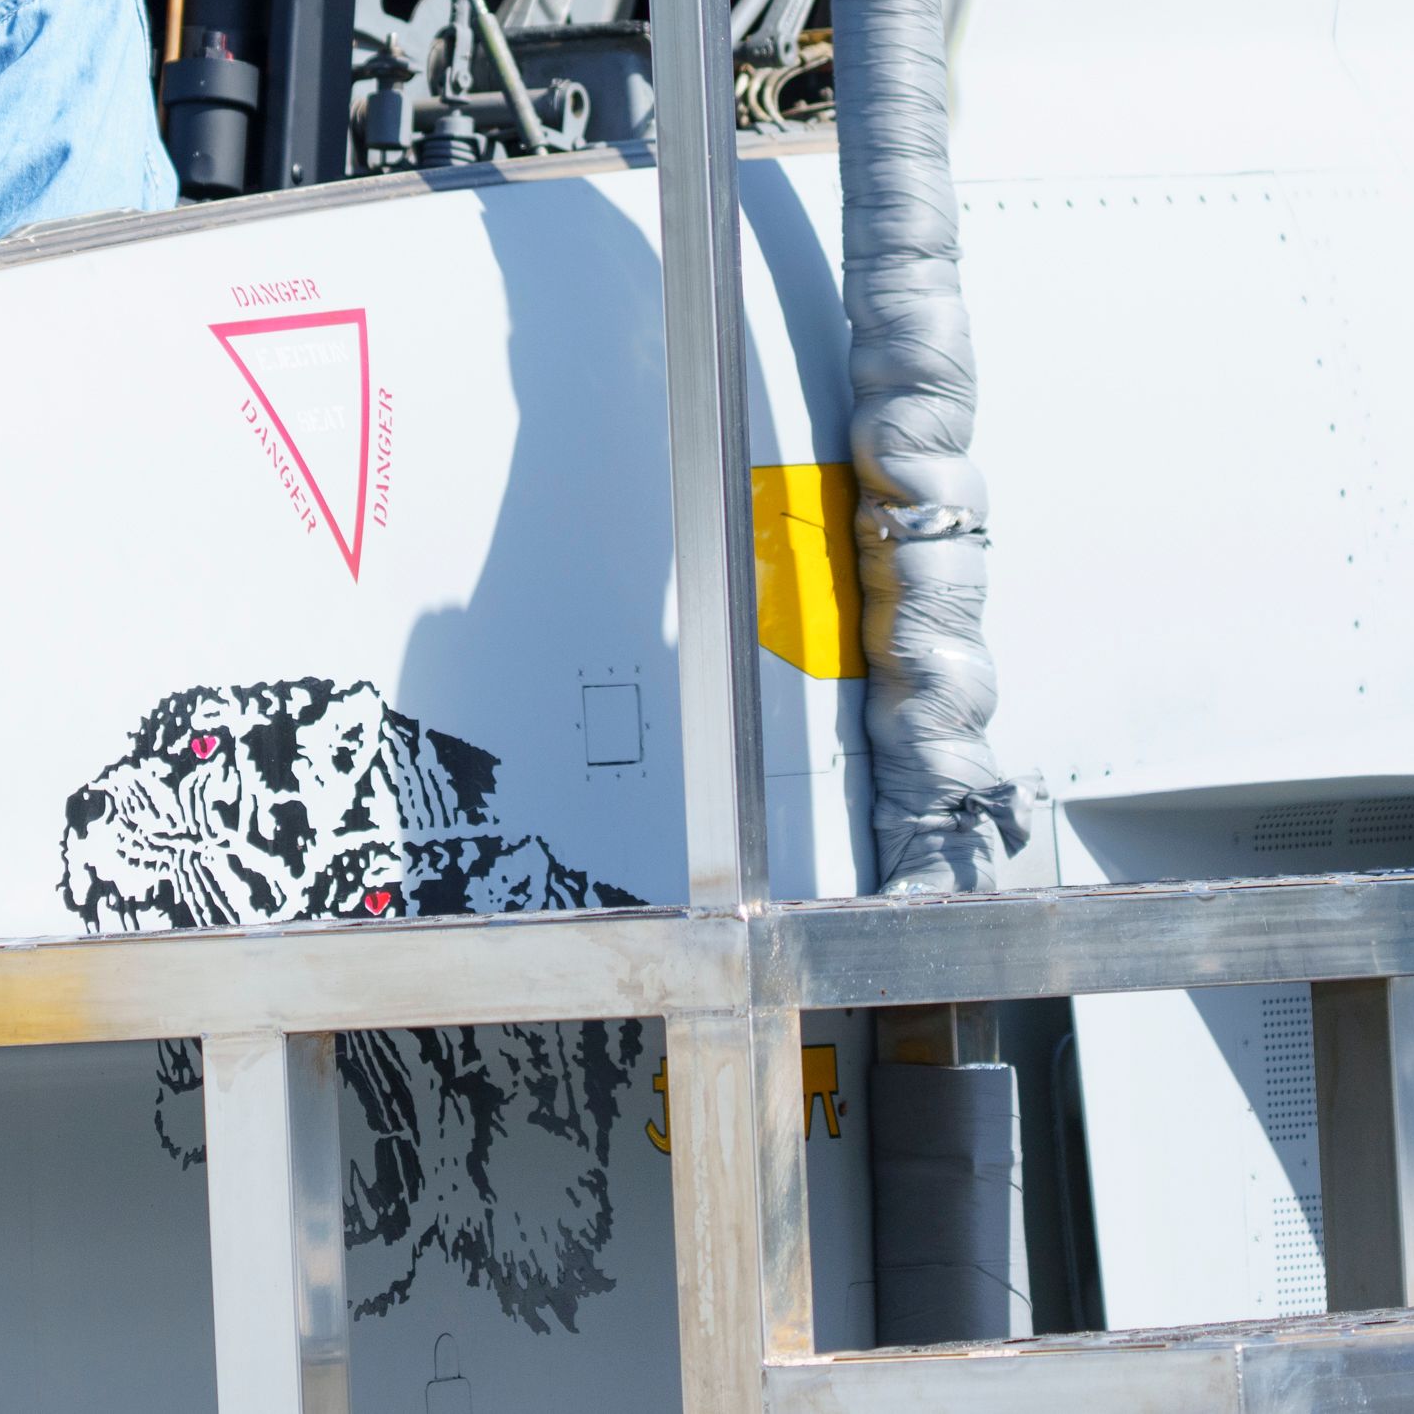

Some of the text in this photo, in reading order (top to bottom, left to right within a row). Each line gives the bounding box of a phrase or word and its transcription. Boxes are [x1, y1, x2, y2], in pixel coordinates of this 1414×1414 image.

[231, 278, 321, 308] DANGER
[253, 339, 350, 372] EJECTION
[296, 405, 346, 435] SEAT
[240, 398, 317, 535] DANGER
[373, 387, 394, 528] DANGER
